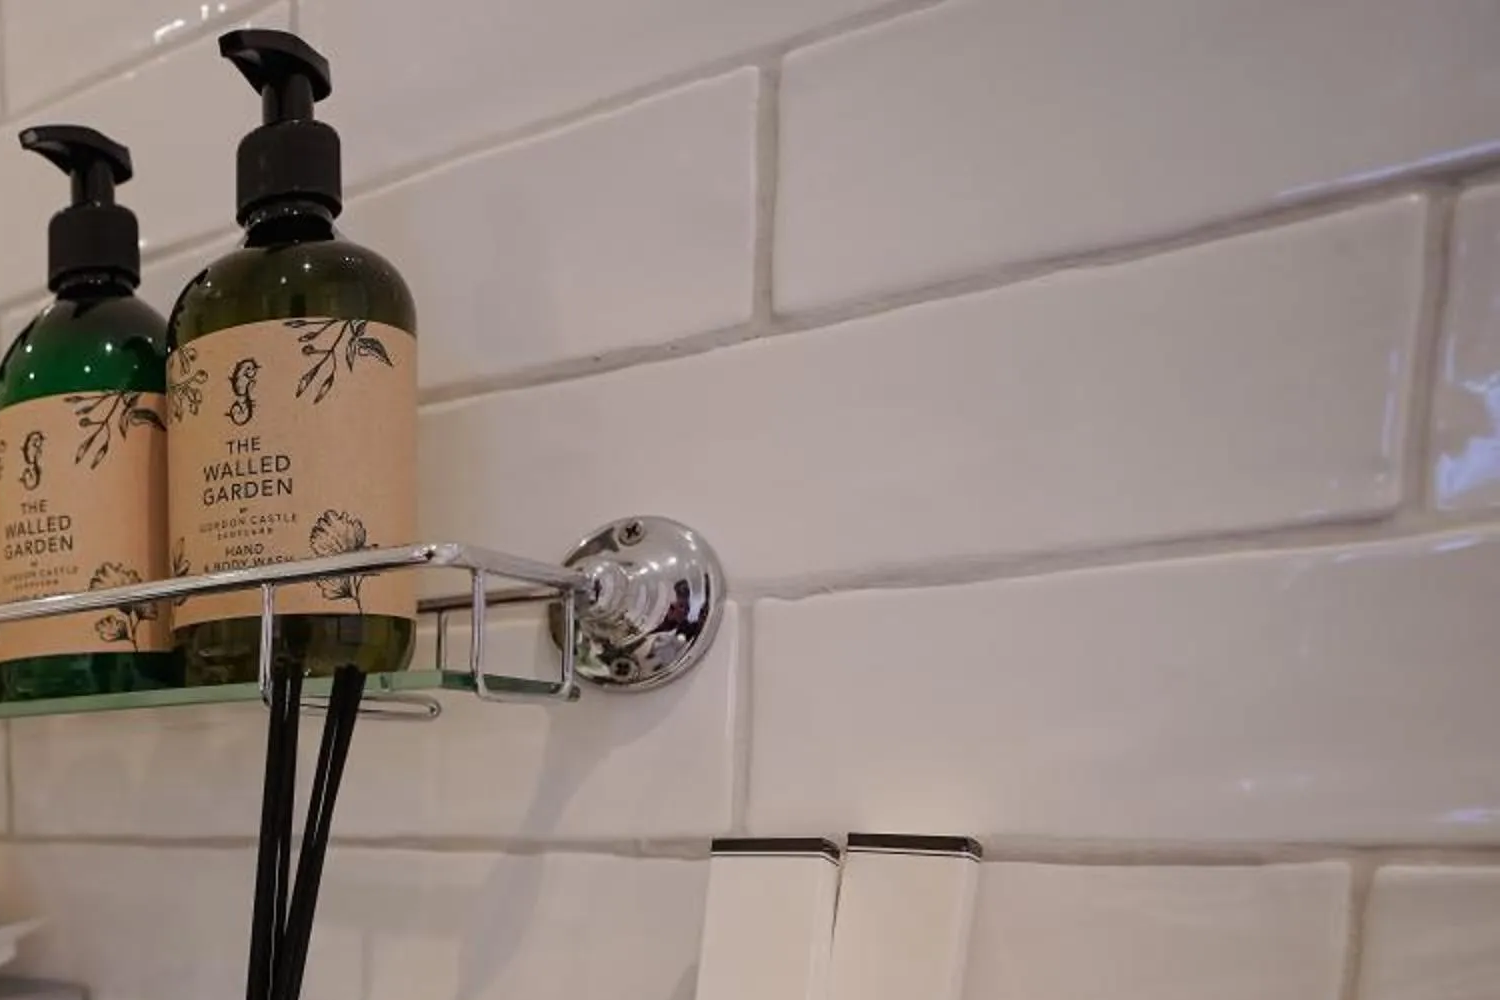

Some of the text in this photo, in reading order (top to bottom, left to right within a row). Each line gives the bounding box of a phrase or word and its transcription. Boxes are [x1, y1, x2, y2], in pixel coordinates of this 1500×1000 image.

[226, 436, 261, 455] THE
[203, 455, 291, 482] WALLED
[203, 478, 293, 506] GARDEN
[20, 499, 48, 515] THE
[4, 515, 71, 540] WALLED
[251, 512, 297, 525] CASTLE
[3, 535, 73, 560] GARDEN
[225, 543, 265, 557] HAND
